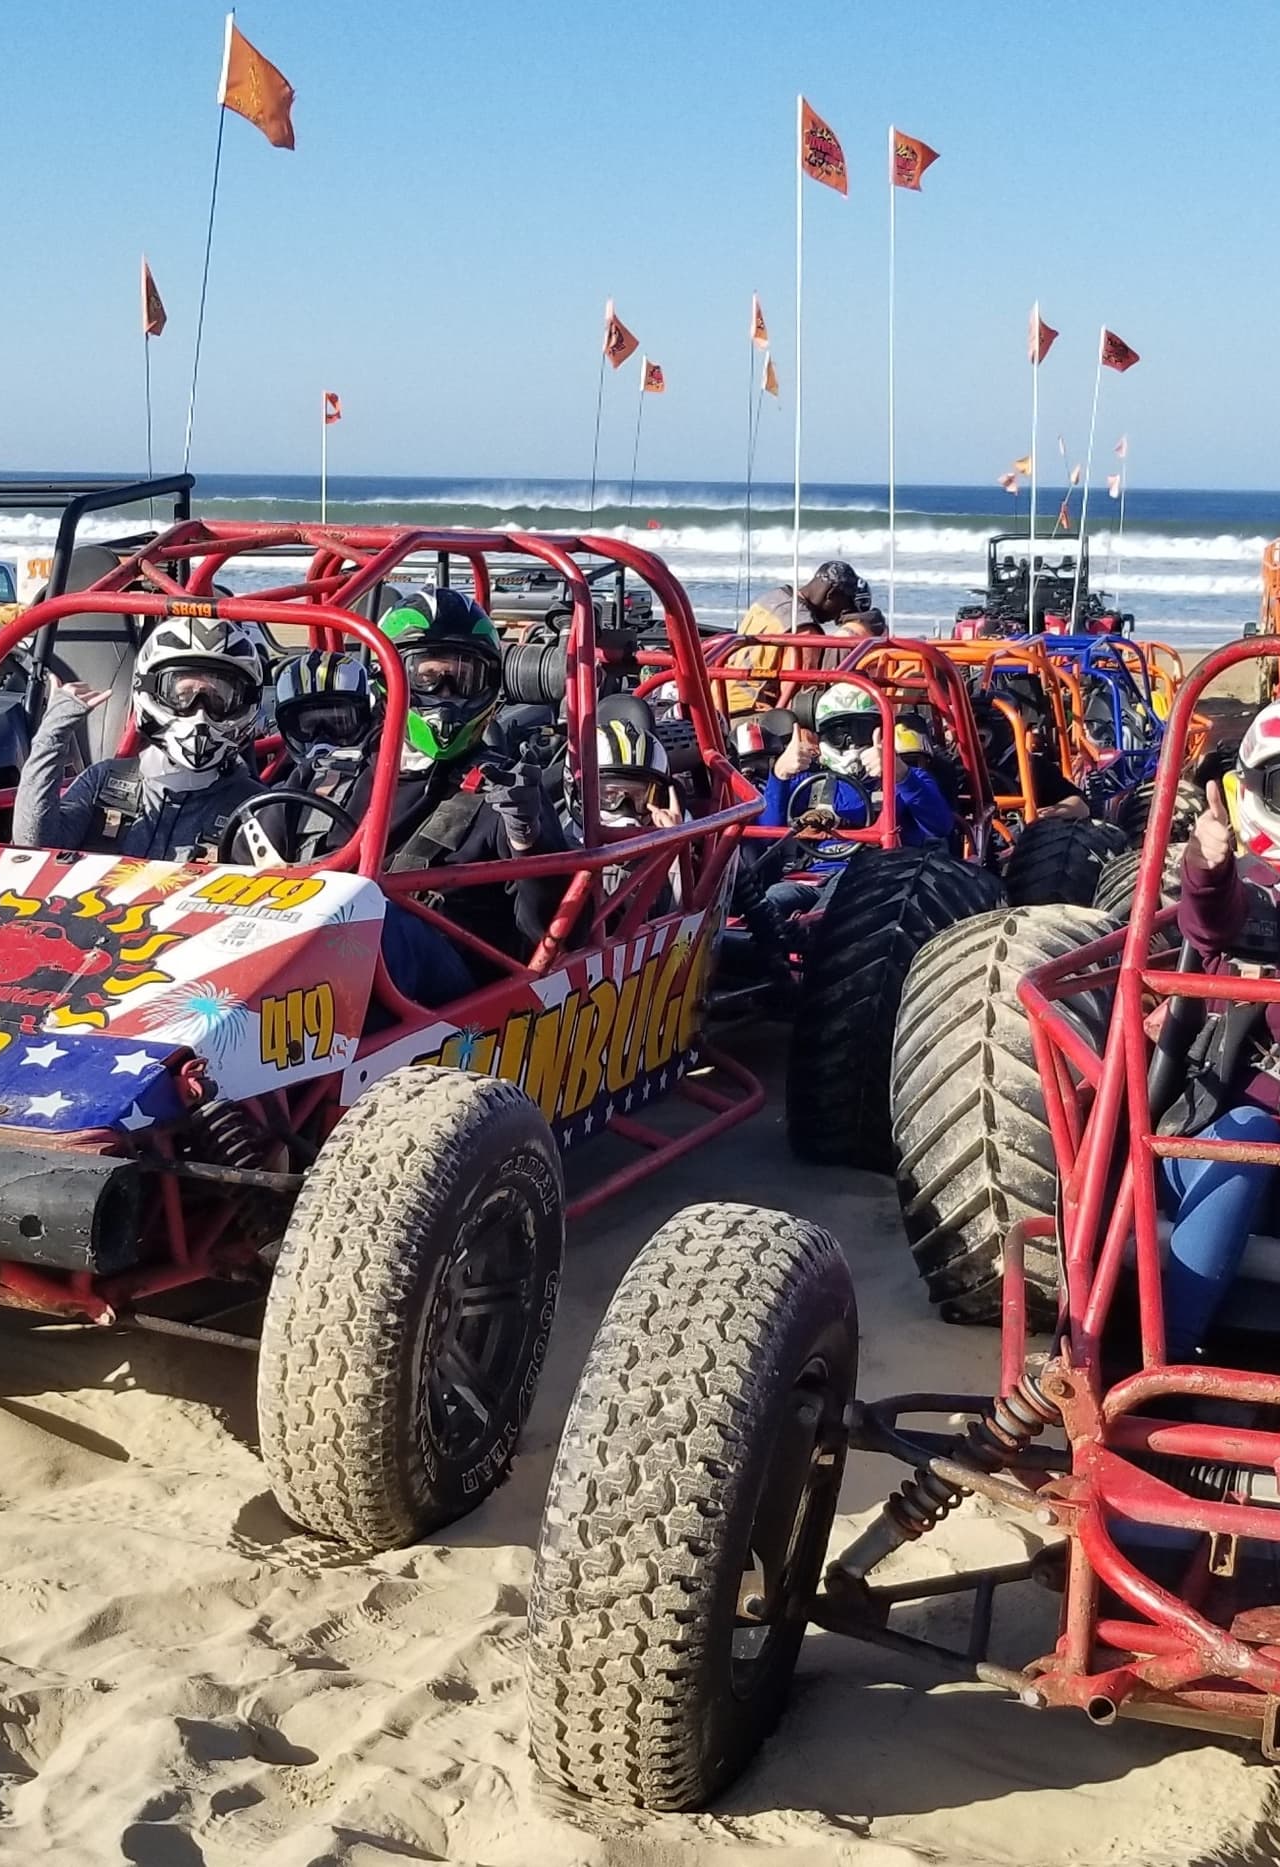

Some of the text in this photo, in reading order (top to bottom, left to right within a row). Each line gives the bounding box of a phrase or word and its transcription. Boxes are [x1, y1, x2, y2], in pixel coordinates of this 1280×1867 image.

[171, 602, 212, 617] SB419
[190, 873, 327, 911] 419
[261, 982, 336, 1072] 419
